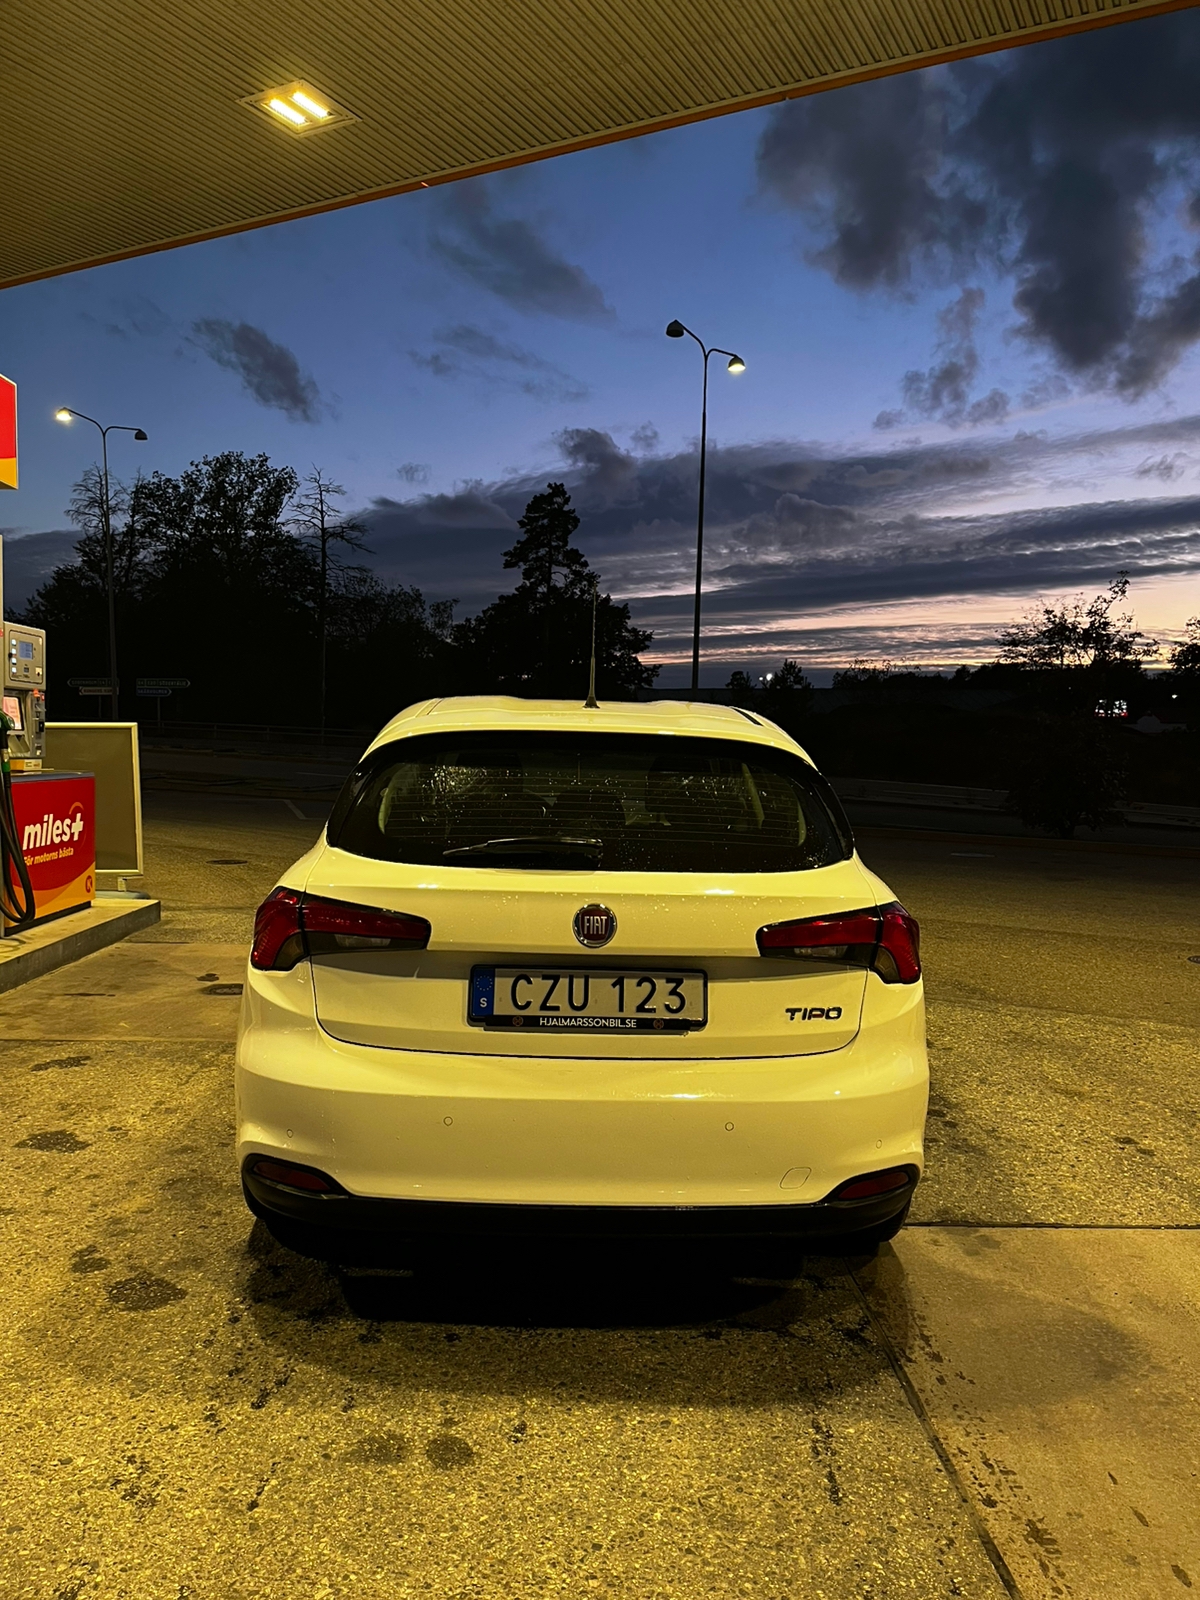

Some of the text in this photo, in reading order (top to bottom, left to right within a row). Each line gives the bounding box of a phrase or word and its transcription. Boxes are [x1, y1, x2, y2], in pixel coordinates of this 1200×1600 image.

[33, 850, 58, 864] motorns
[58, 846, 74, 859] bästa
[584, 916, 608, 934] FIAT
[511, 974, 687, 1014] CZU 123
[480, 997, 487, 1008] S
[785, 1006, 843, 1021] TIPO
[539, 1017, 637, 1028] HJALMARSSONBIL.SE
